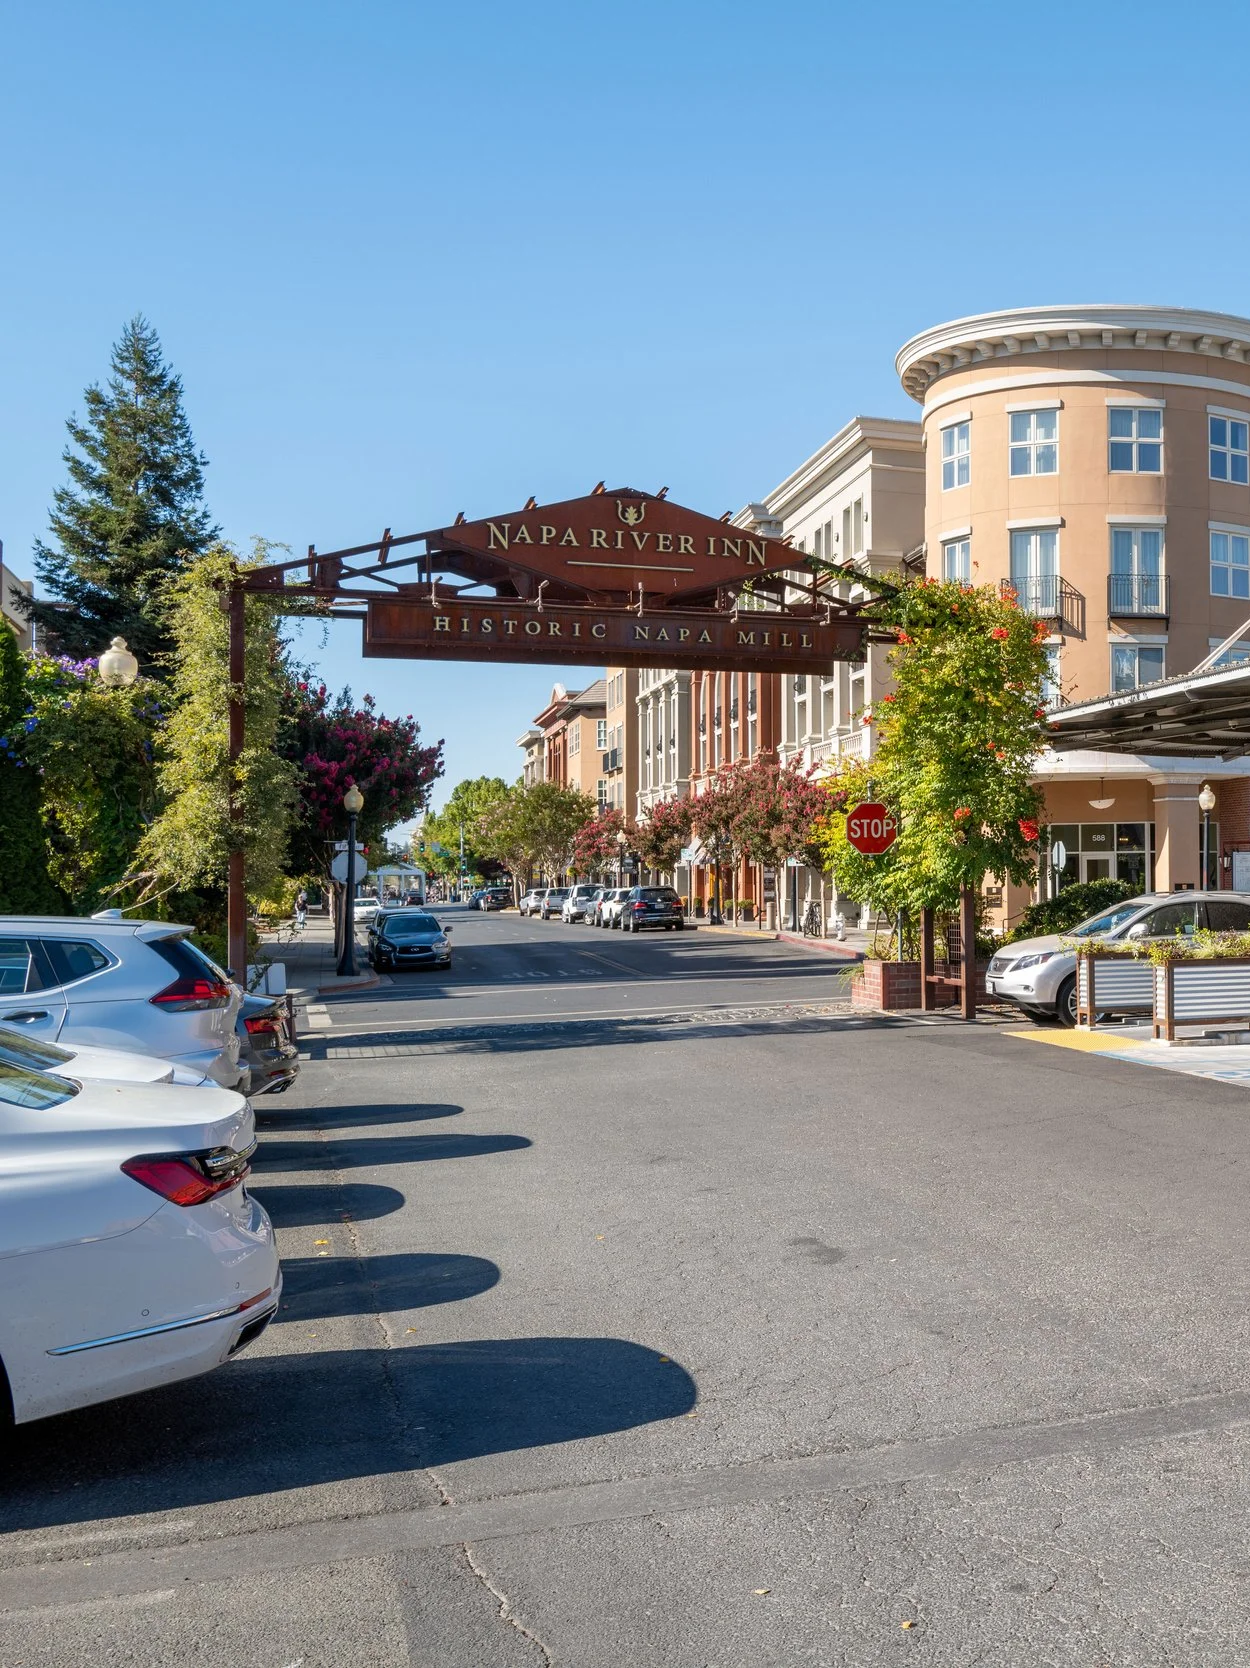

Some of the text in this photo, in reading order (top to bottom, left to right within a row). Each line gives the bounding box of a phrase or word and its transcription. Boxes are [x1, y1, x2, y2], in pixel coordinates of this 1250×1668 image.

[486, 522, 768, 566] NAPA RIVER INN
[433, 616, 813, 649] HISTORIC NAPA MILL
[850, 818, 894, 839] STOP
[1092, 834, 1106, 842] 588
